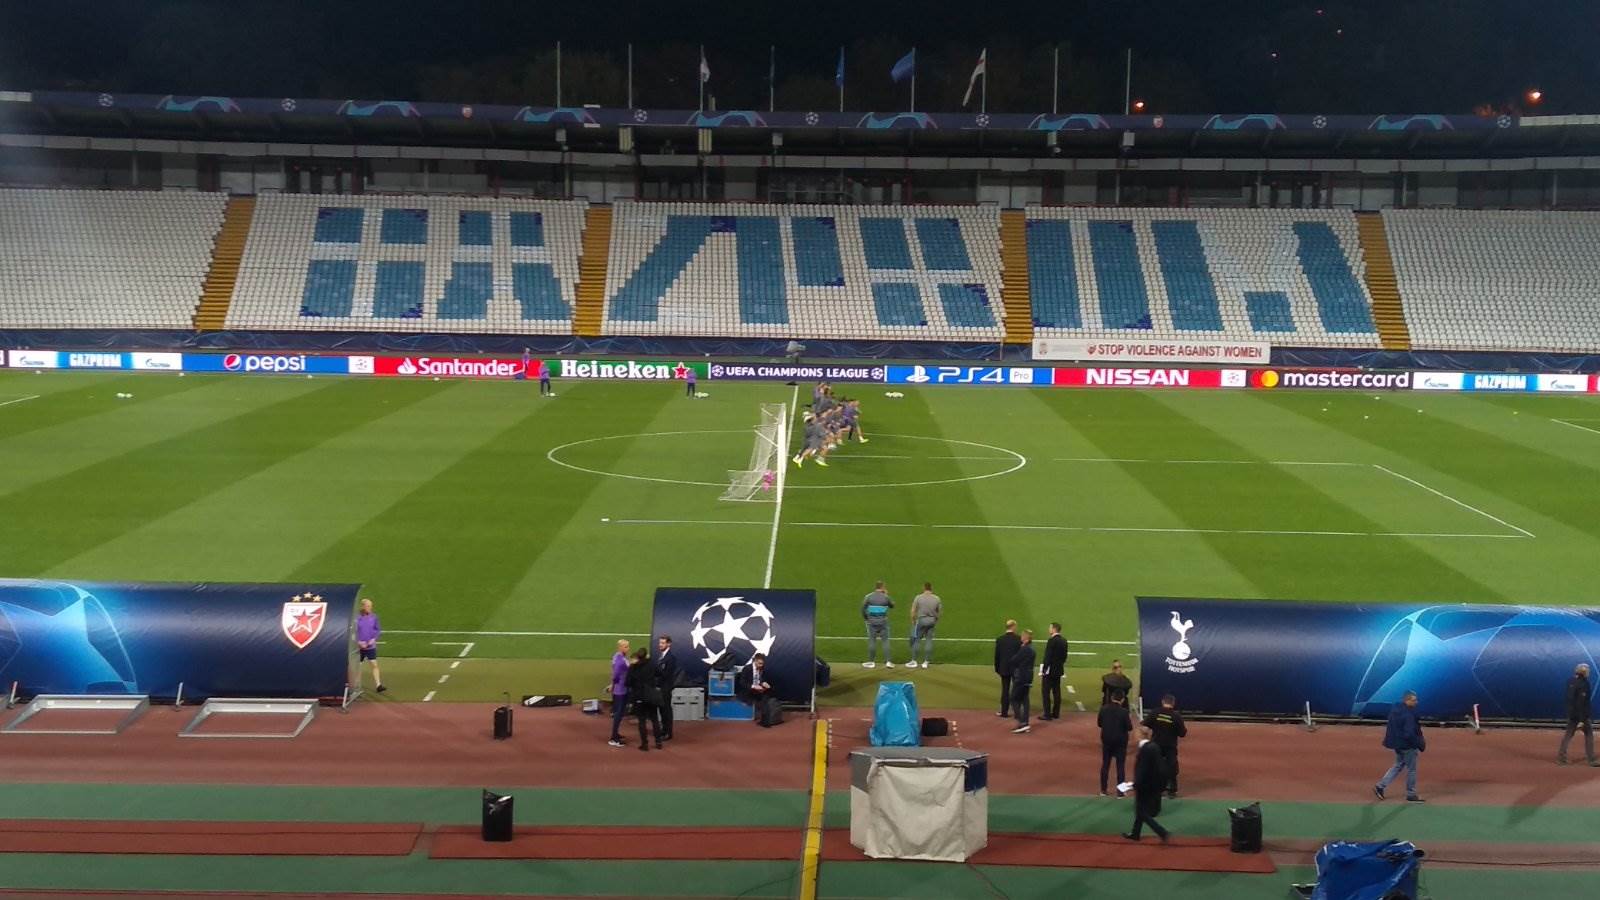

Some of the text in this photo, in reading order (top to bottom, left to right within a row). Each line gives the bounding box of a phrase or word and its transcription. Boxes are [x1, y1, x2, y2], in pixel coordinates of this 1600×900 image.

[1098, 345, 1262, 359] STOP VIOLENCE AGAINST WOMEN
[246, 355, 306, 371] pepsi
[419, 359, 517, 376] Santander
[560, 360, 670, 378] Heineken
[726, 367, 869, 379] UEFA CHAMPIONS LEAGUE
[938, 367, 1029, 383] PS4 Pro
[1086, 369, 1189, 385] NISSAN
[1283, 371, 1408, 387] mastercard
